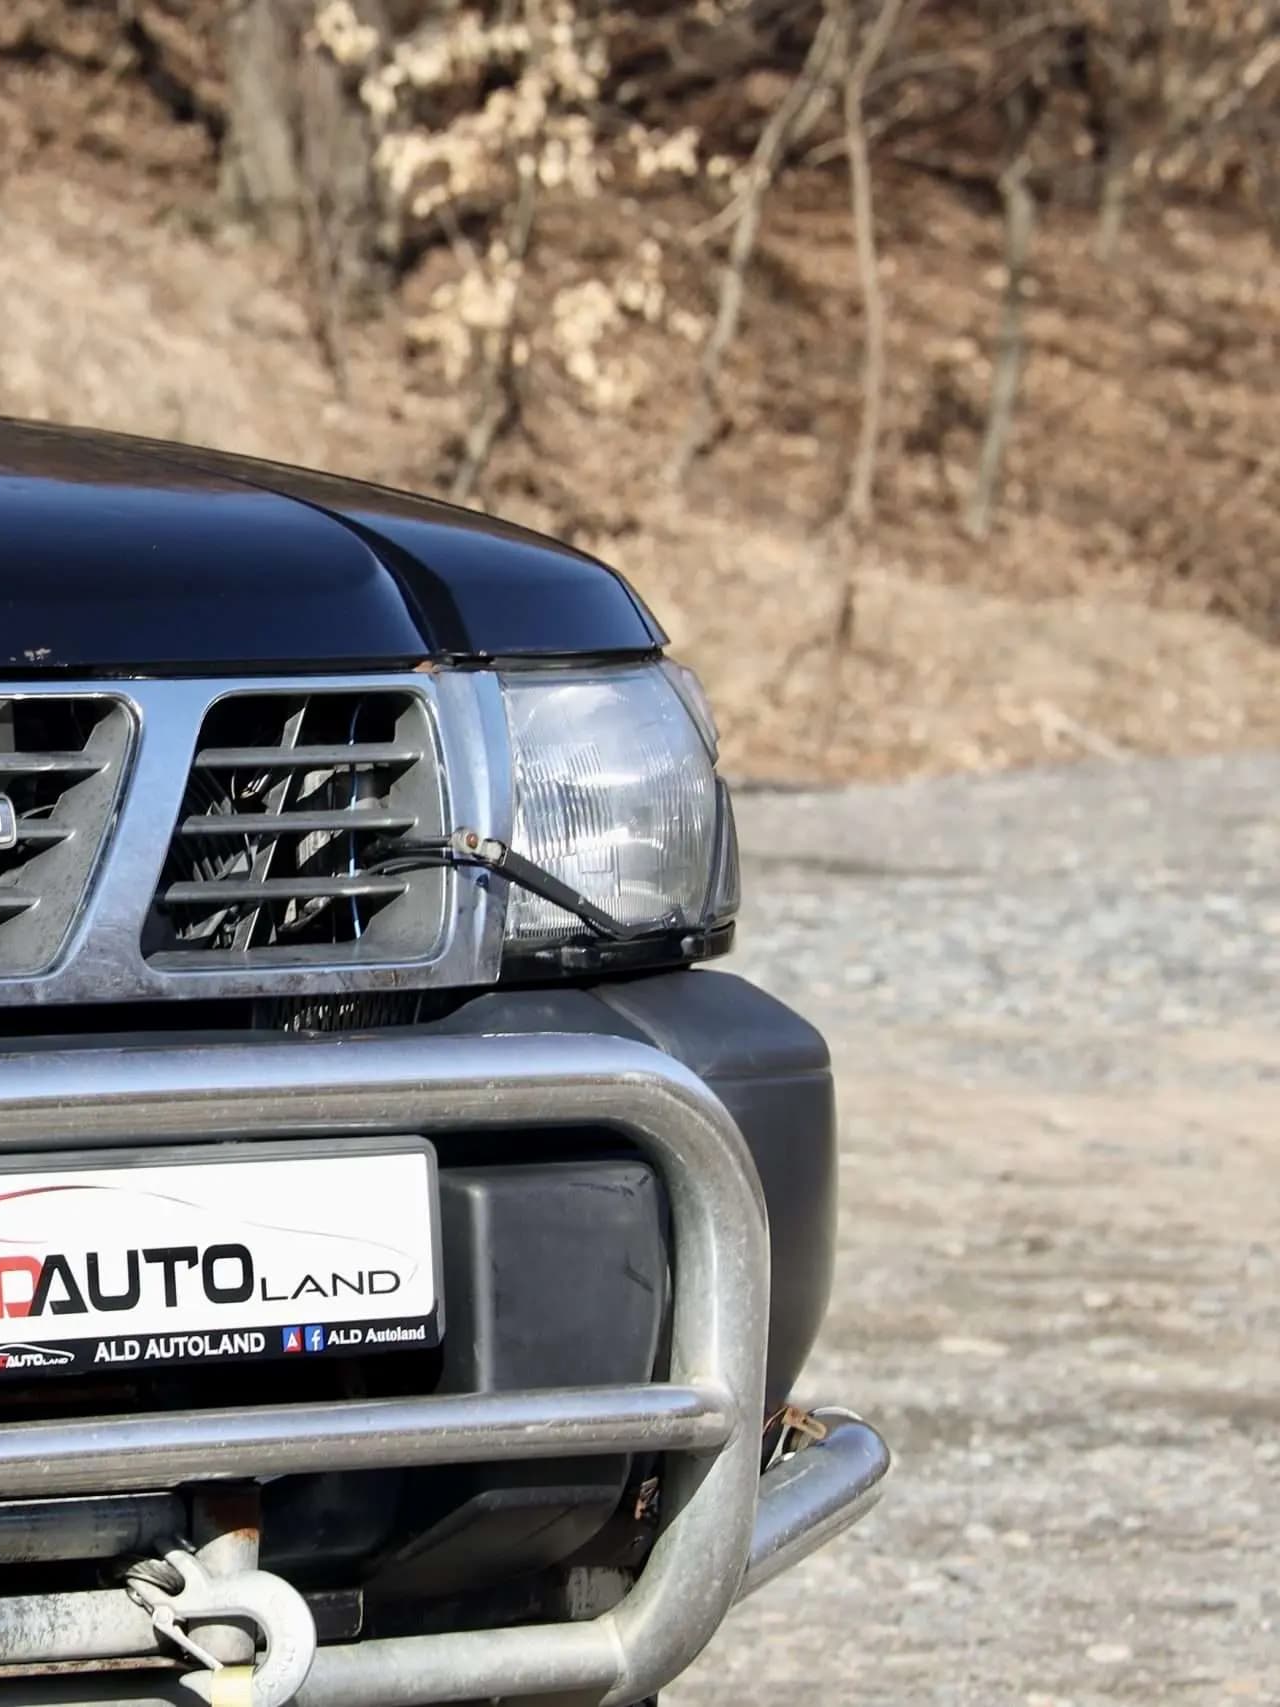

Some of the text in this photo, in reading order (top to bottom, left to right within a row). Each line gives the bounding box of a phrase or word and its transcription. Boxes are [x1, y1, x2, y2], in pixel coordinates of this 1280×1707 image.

[94, 1332, 266, 1363] ALD AUTOLAND
[327, 1328, 363, 1345] ALD
[365, 1324, 426, 1344] Autoland
